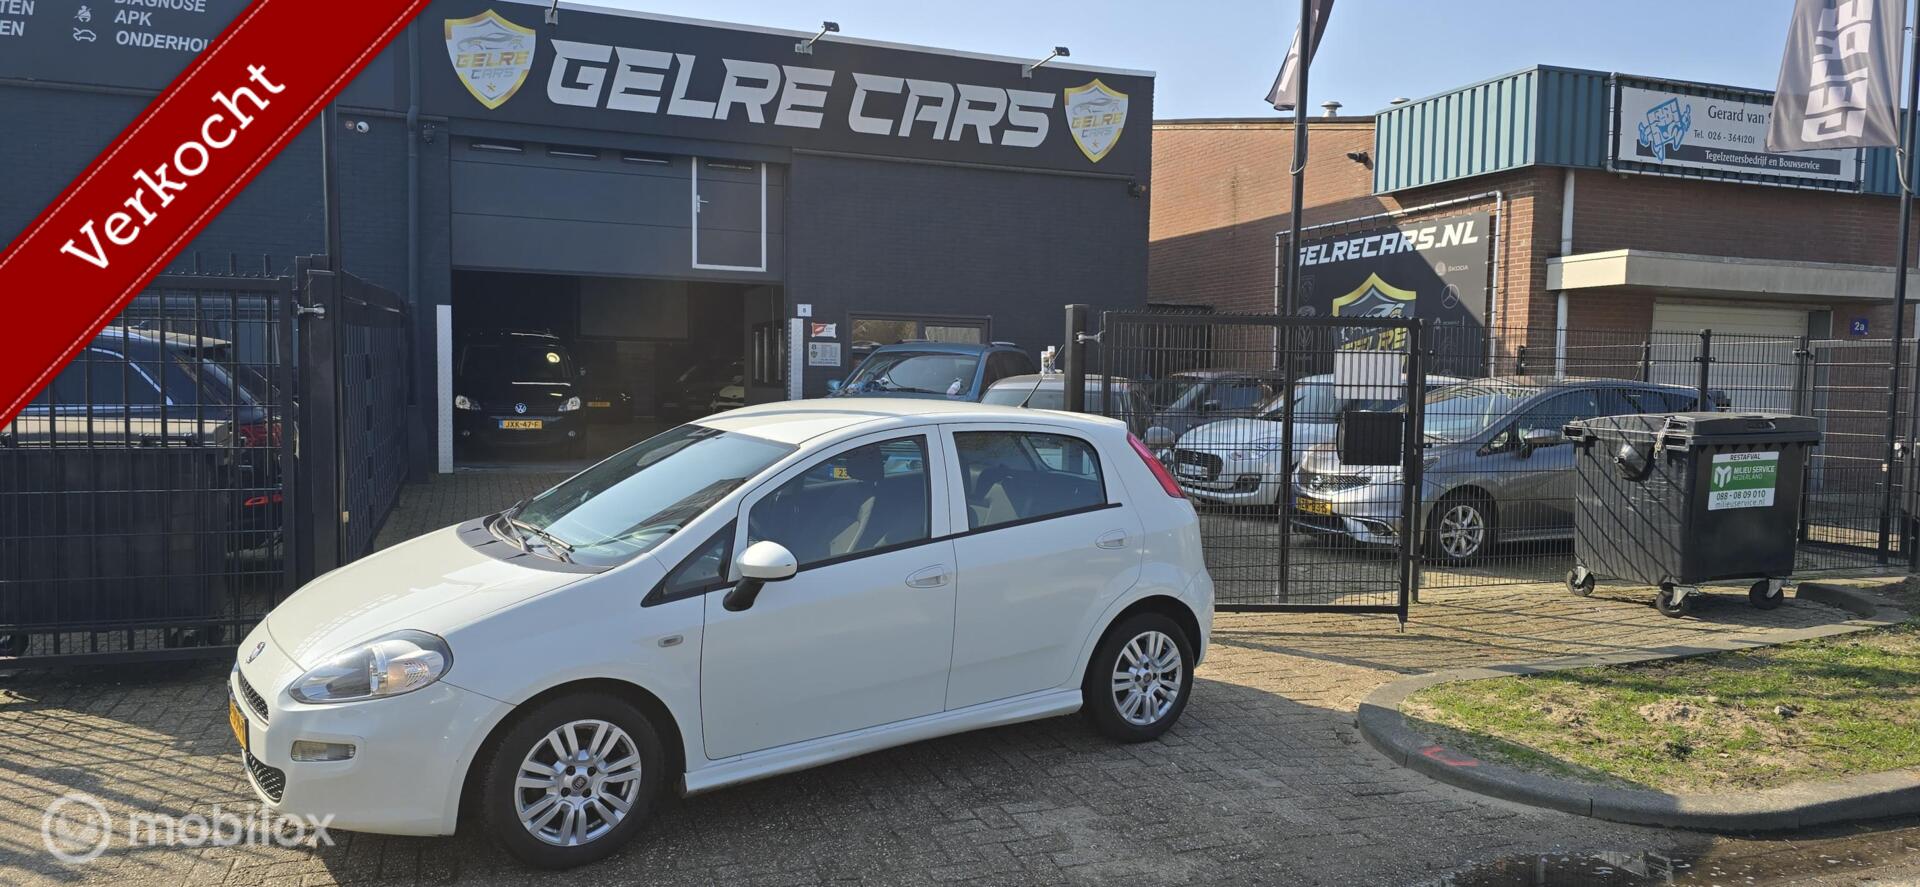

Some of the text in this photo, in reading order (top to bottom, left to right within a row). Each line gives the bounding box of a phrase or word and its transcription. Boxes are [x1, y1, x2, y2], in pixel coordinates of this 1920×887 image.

[114, 0, 206, 12] GNOSE
[114, 9, 152, 26] APK
[456, 51, 529, 68] GELRE
[470, 67, 513, 80] CARS
[547, 39, 1056, 148] GELRE CARS
[1708, 105, 1744, 122] Gerard
[1747, 112, 1765, 125] van
[1707, 131, 1721, 141] 026
[1704, 150, 1820, 170] Tegelzettersbedrijf en Bouwservice
[1854, 321, 1865, 331] 2a
[1730, 453, 1761, 461] RESTAFVAL
[1733, 465, 1776, 475] MILIEU SERVICE
[1716, 492, 1729, 501] 088
[1733, 491, 1742, 500] 08
[1743, 490, 1752, 499] 09
[1752, 489, 1766, 498] 010
